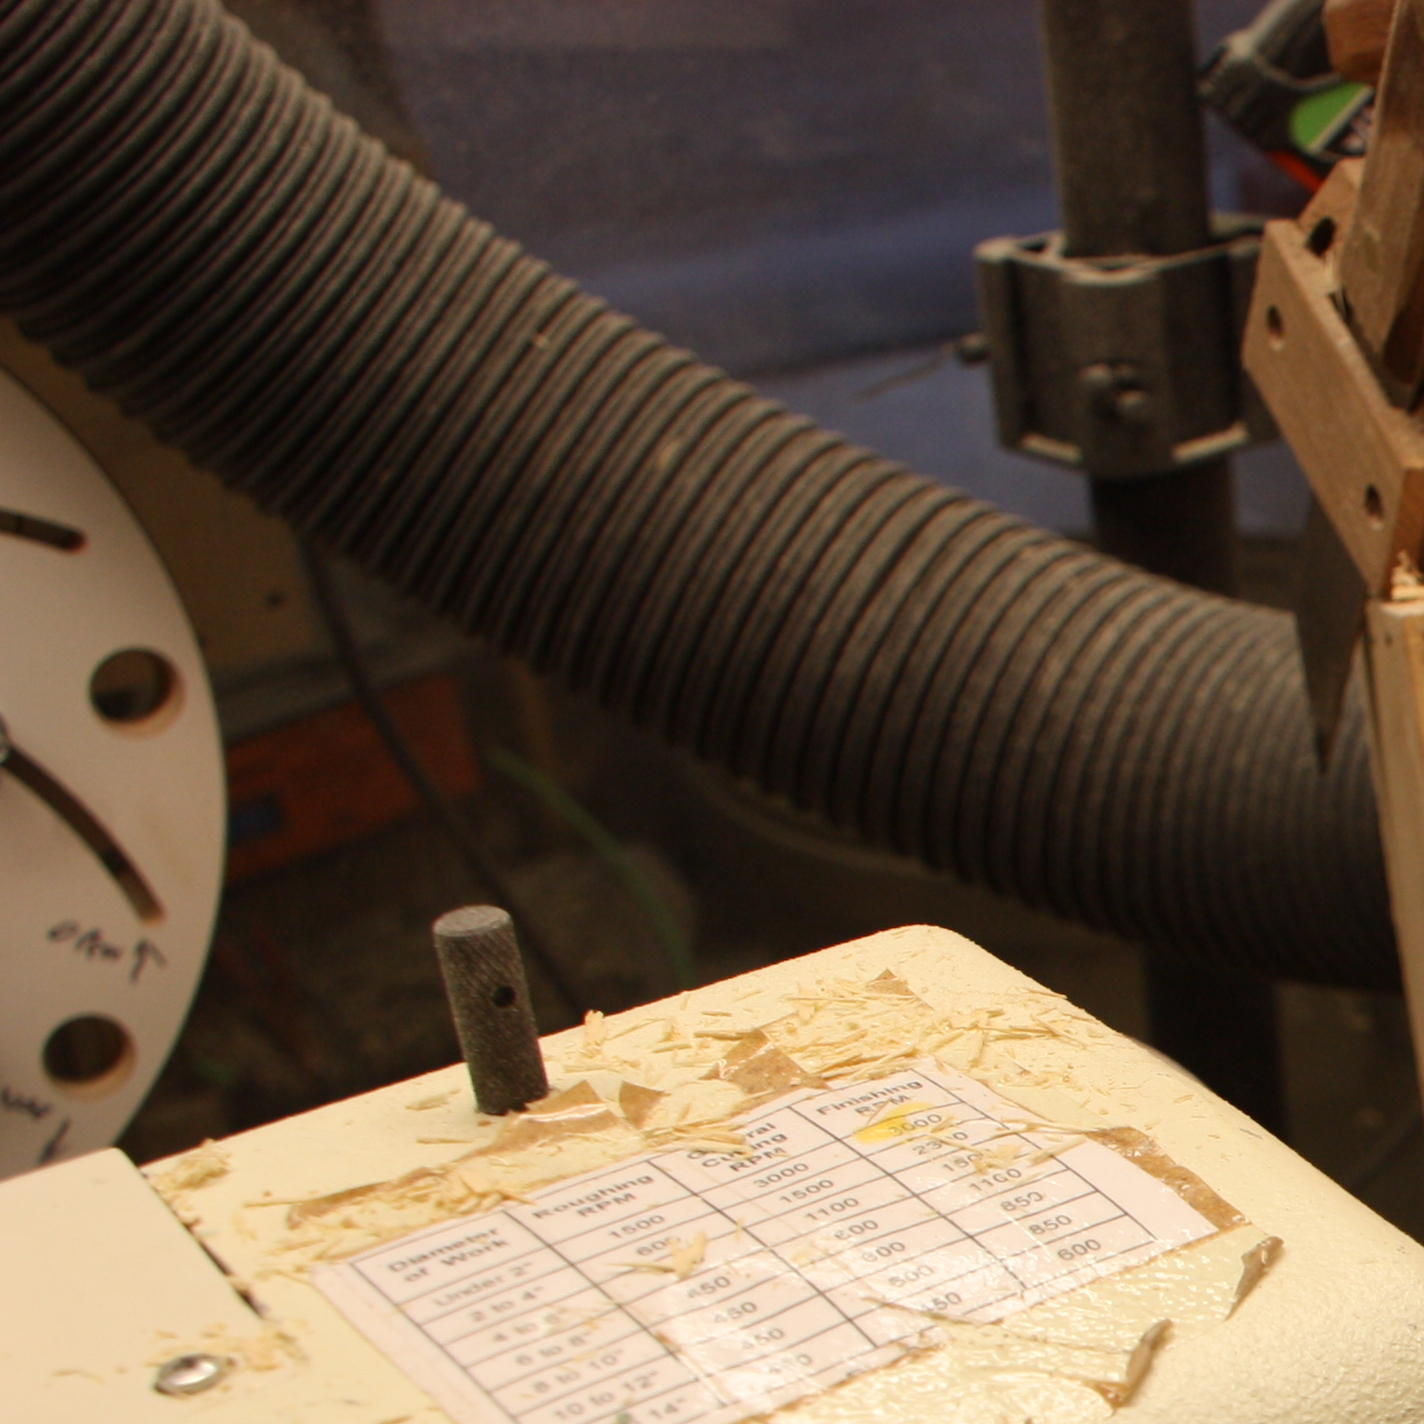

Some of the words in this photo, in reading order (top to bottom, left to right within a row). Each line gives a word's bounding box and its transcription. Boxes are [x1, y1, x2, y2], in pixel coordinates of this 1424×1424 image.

[815, 1080, 923, 1116] Finishing
[911, 1131, 969, 1156] 230
[729, 1146, 787, 1172] RPM
[752, 1162, 811, 1189] 3000
[531, 1175, 655, 1219] Roughing
[778, 1178, 835, 1204] 1500
[1000, 1190, 1045, 1212] 850
[576, 1192, 637, 1217] RPM
[804, 1197, 860, 1221] 1100
[608, 1214, 666, 1239] 1500
[1028, 1214, 1074, 1236] 850
[387, 1229, 499, 1272] Diameter
[441, 1239, 509, 1267] Work
[1056, 1238, 1102, 1262] 600
